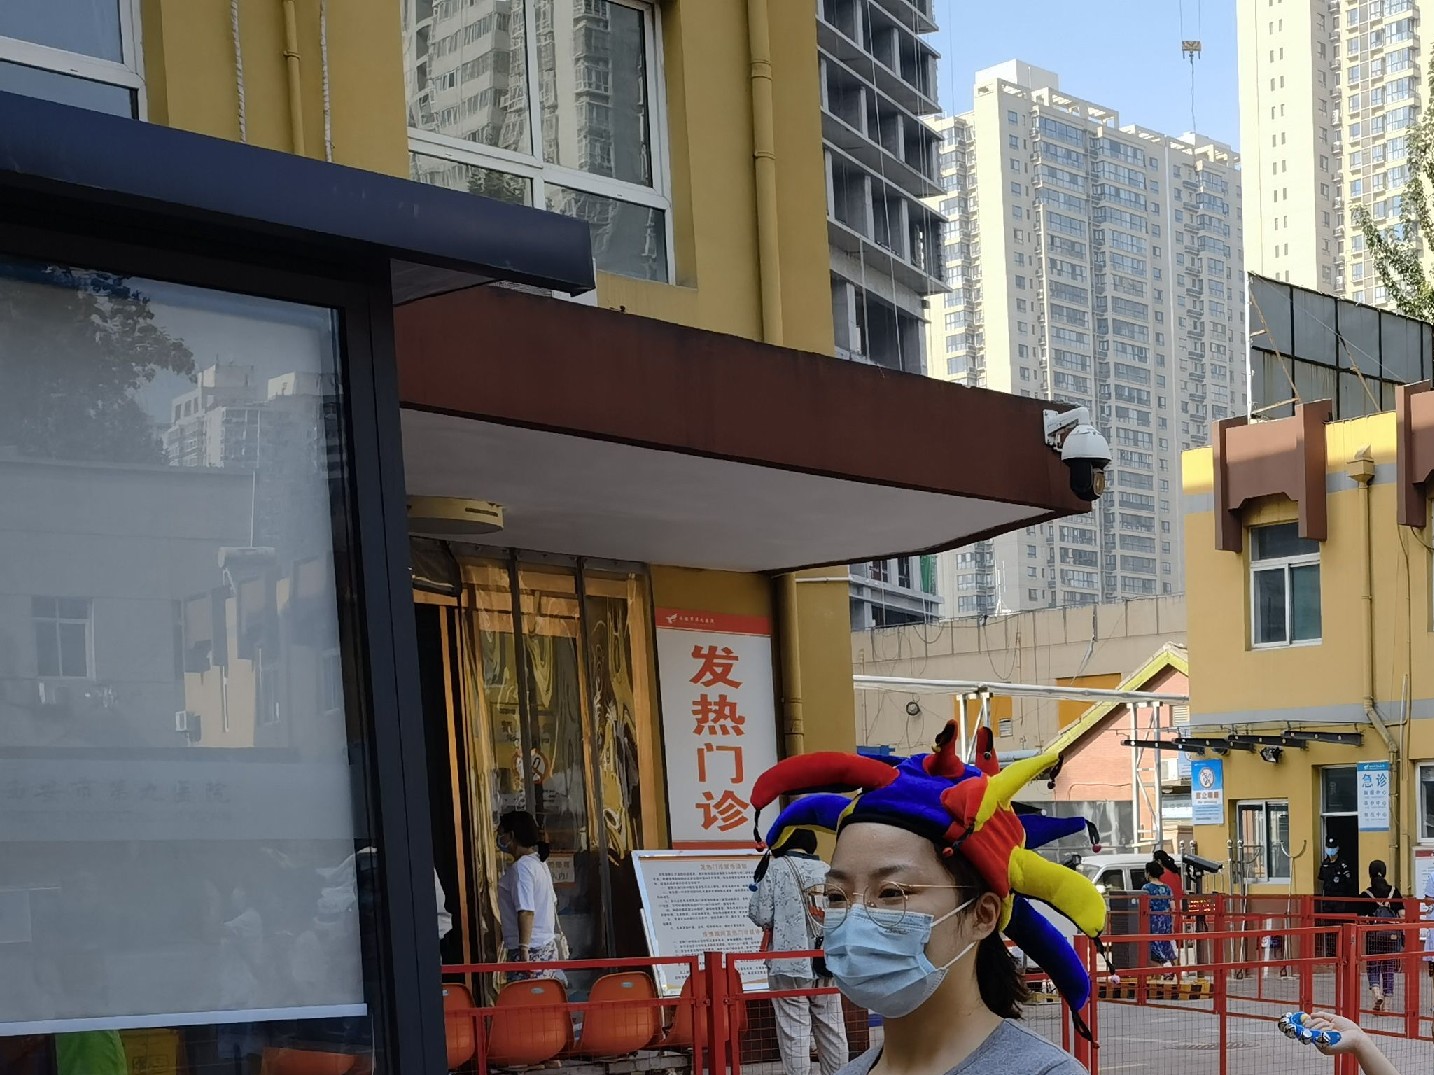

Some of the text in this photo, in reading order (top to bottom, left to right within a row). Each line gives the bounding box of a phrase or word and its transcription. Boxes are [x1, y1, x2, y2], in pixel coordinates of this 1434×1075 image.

[689, 644, 750, 832] 发热门诊
[1362, 772, 1387, 788] 急诊
